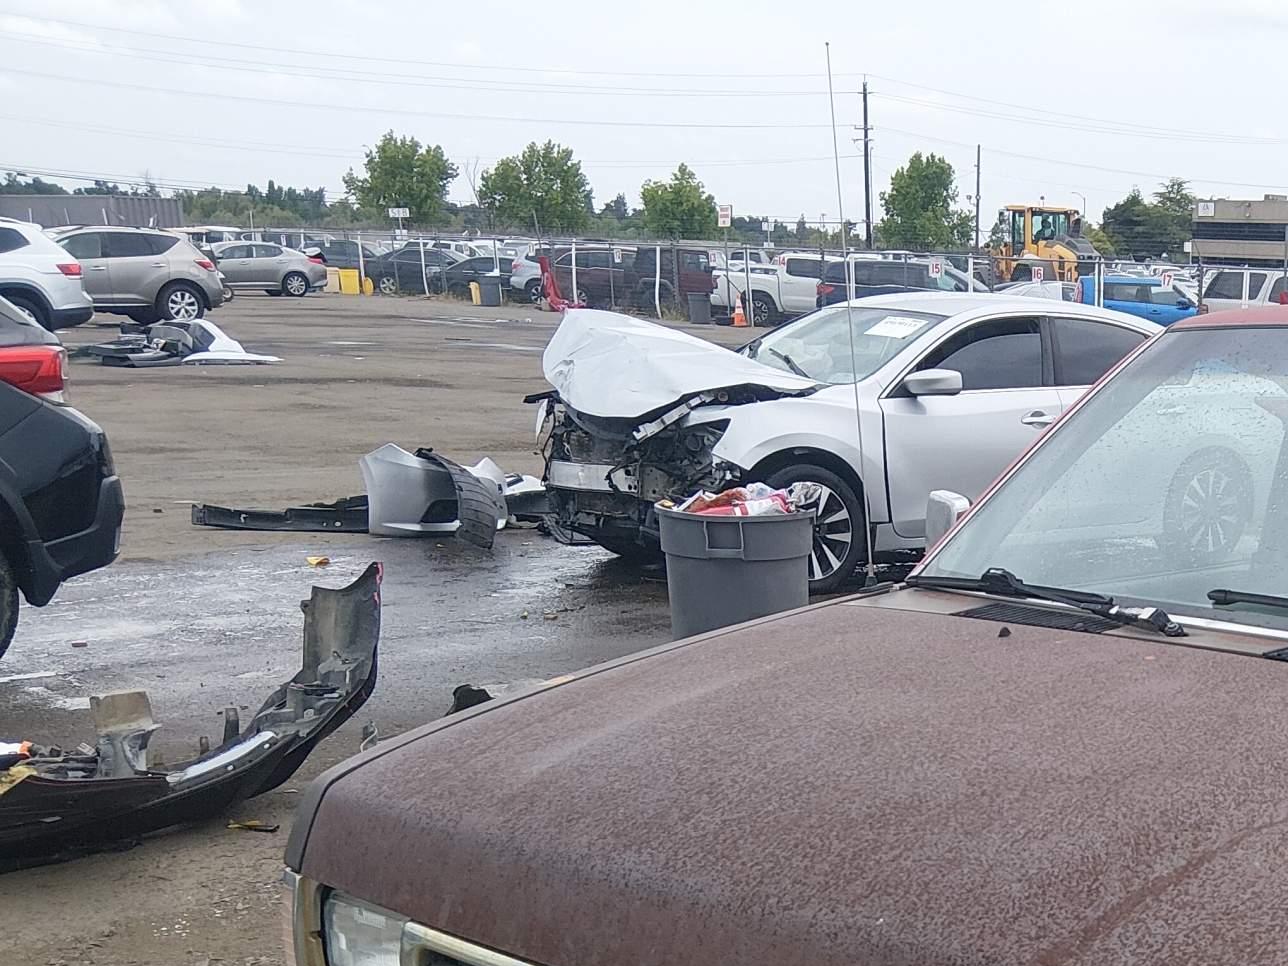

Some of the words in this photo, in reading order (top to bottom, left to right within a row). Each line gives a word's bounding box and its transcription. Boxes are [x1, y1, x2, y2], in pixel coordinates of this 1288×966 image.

[931, 263, 940, 273] 15
[1033, 268, 1042, 279] 16
[1162, 274, 1172, 286] 17
